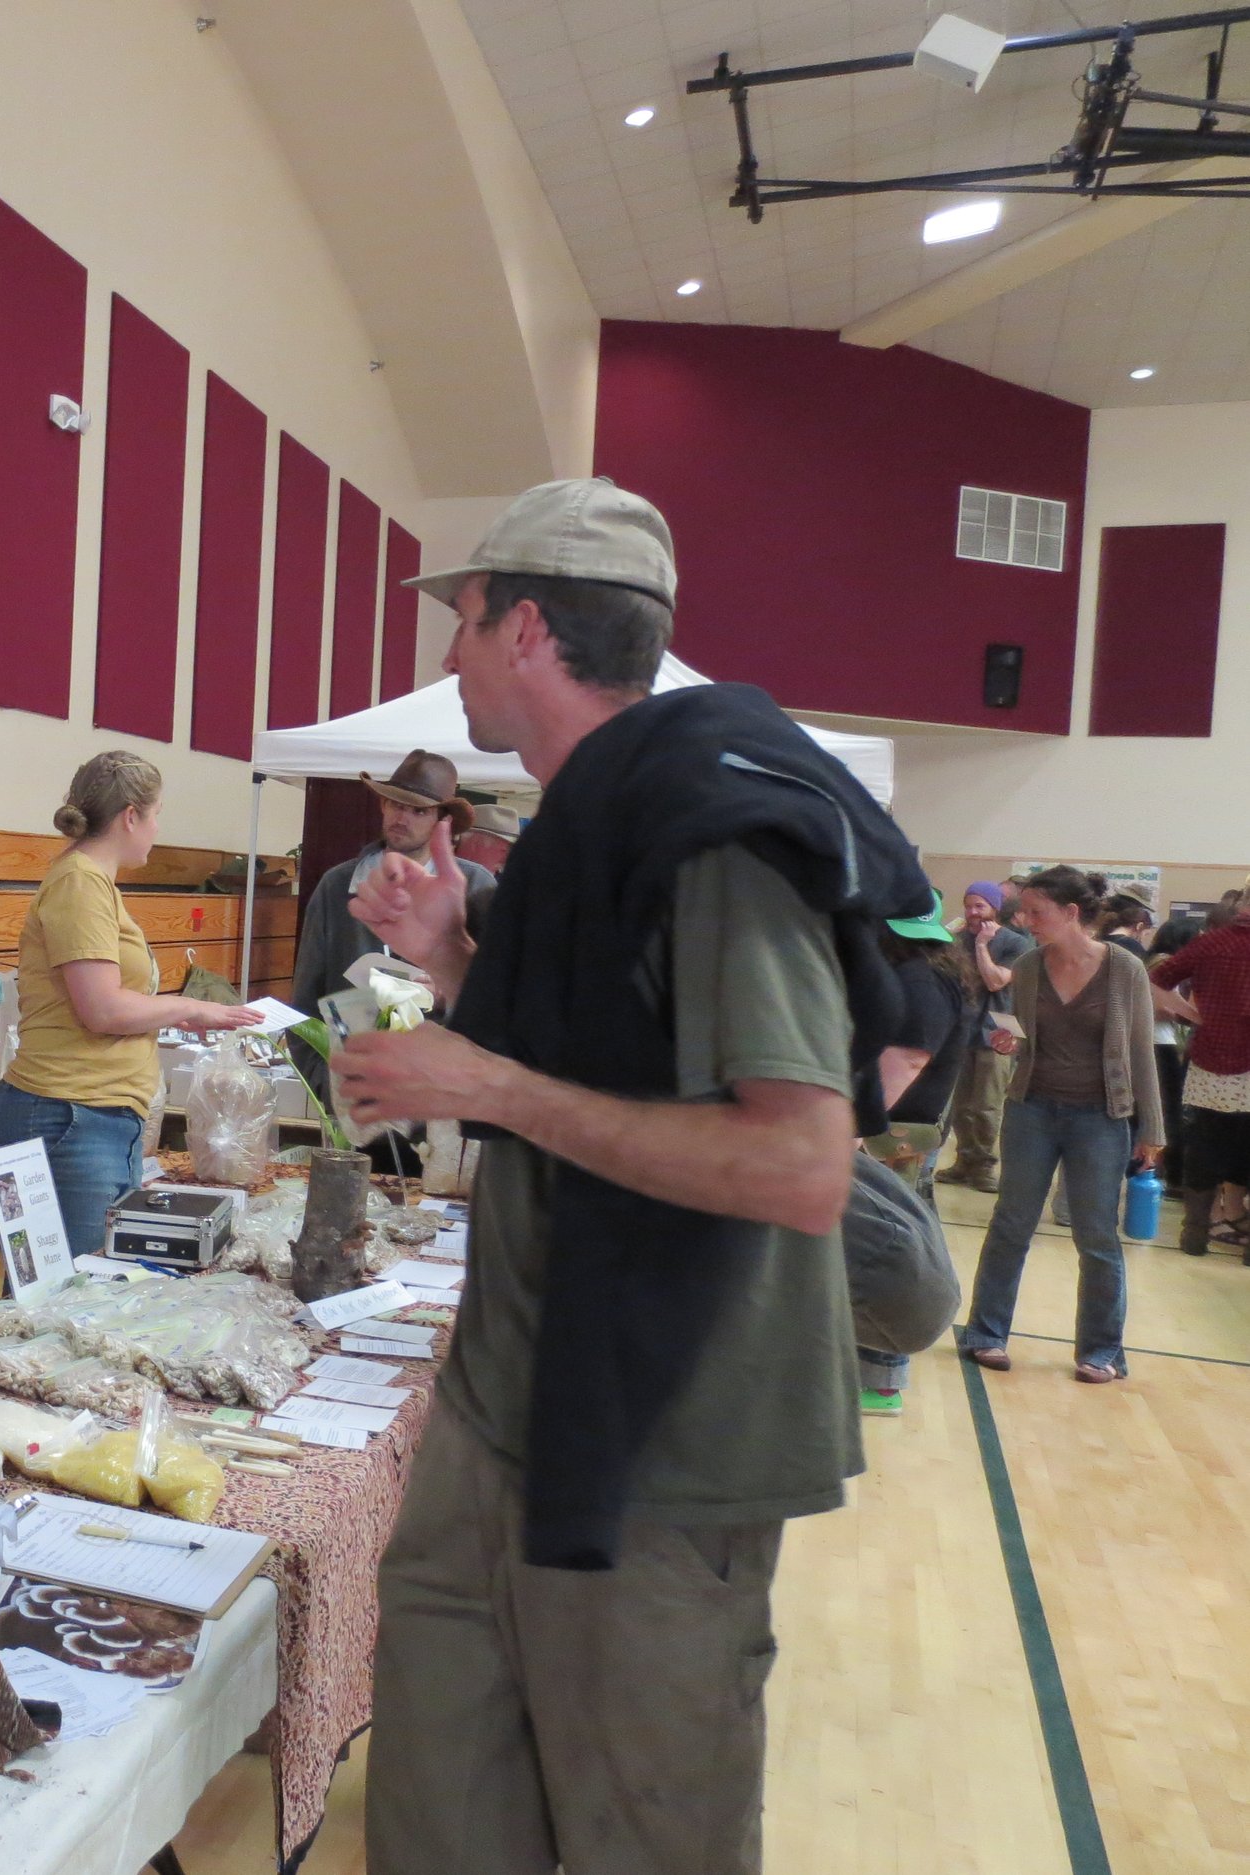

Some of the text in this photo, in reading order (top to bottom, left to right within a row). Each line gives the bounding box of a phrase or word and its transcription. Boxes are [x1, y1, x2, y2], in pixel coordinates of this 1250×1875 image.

[1138, 871, 1158, 881] Soil
[23, 1172, 47, 1187] Garden
[29, 1192, 50, 1206] Giants
[36, 1232, 60, 1248] Shaggy
[43, 1253, 62, 1266] Mane
